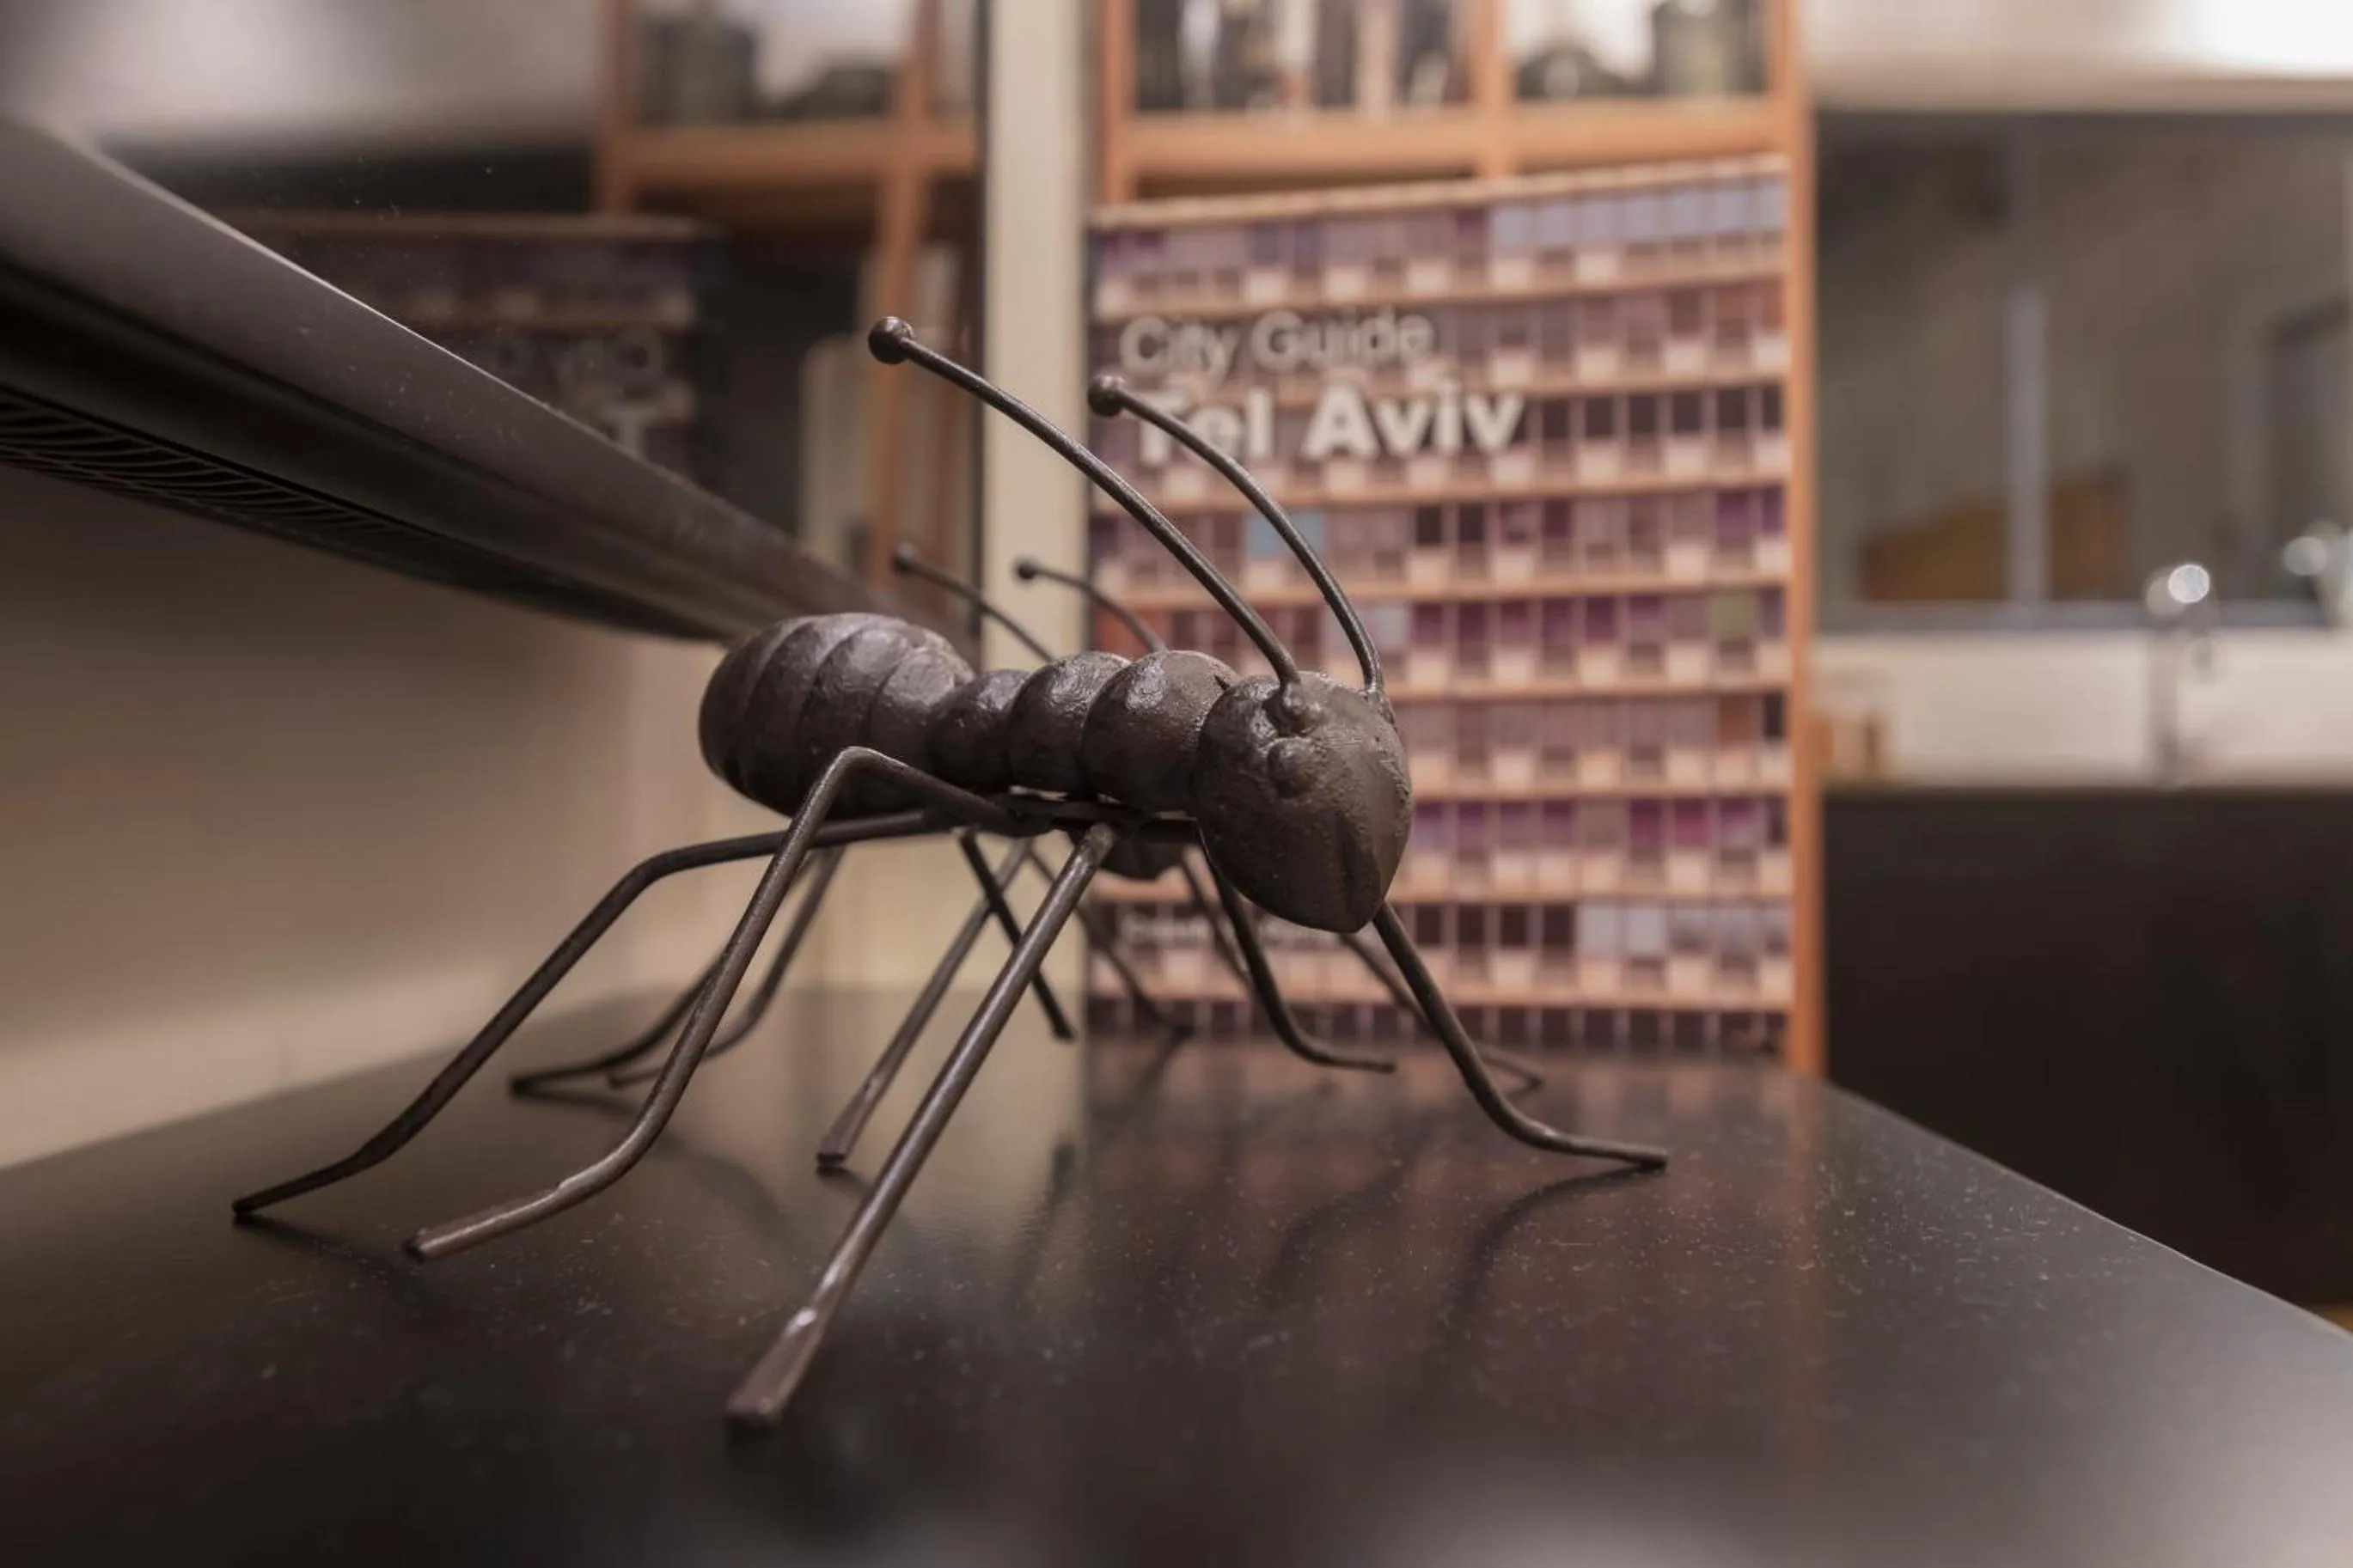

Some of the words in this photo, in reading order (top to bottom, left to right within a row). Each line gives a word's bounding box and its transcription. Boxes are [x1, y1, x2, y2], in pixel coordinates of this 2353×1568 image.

[1120, 314, 1238, 388] City
[1250, 309, 1436, 372] Guide
[1129, 387, 1274, 464] Tel
[1303, 375, 1525, 459] Aviv
